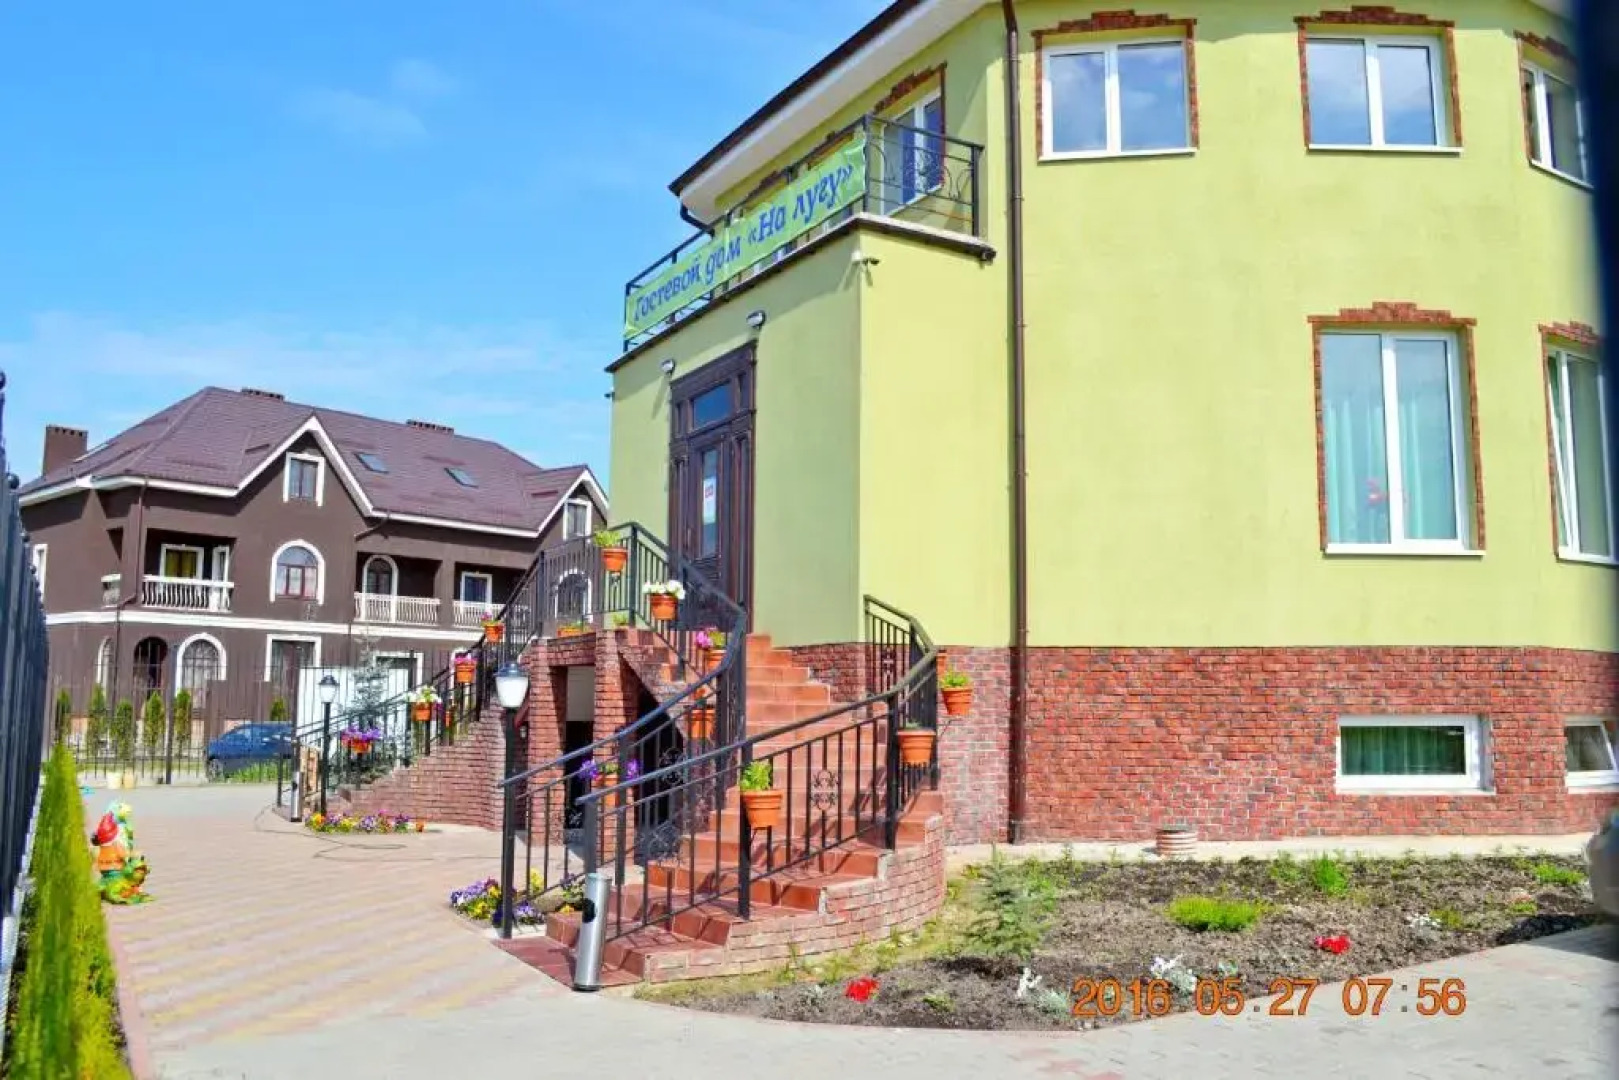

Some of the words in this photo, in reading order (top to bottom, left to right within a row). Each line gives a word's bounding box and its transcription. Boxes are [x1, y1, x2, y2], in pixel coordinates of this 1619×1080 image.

[634, 256, 700, 321] Гостевой
[706, 236, 741, 285] дом
[748, 205, 786, 245] «На
[793, 165, 853, 224] лугу»
